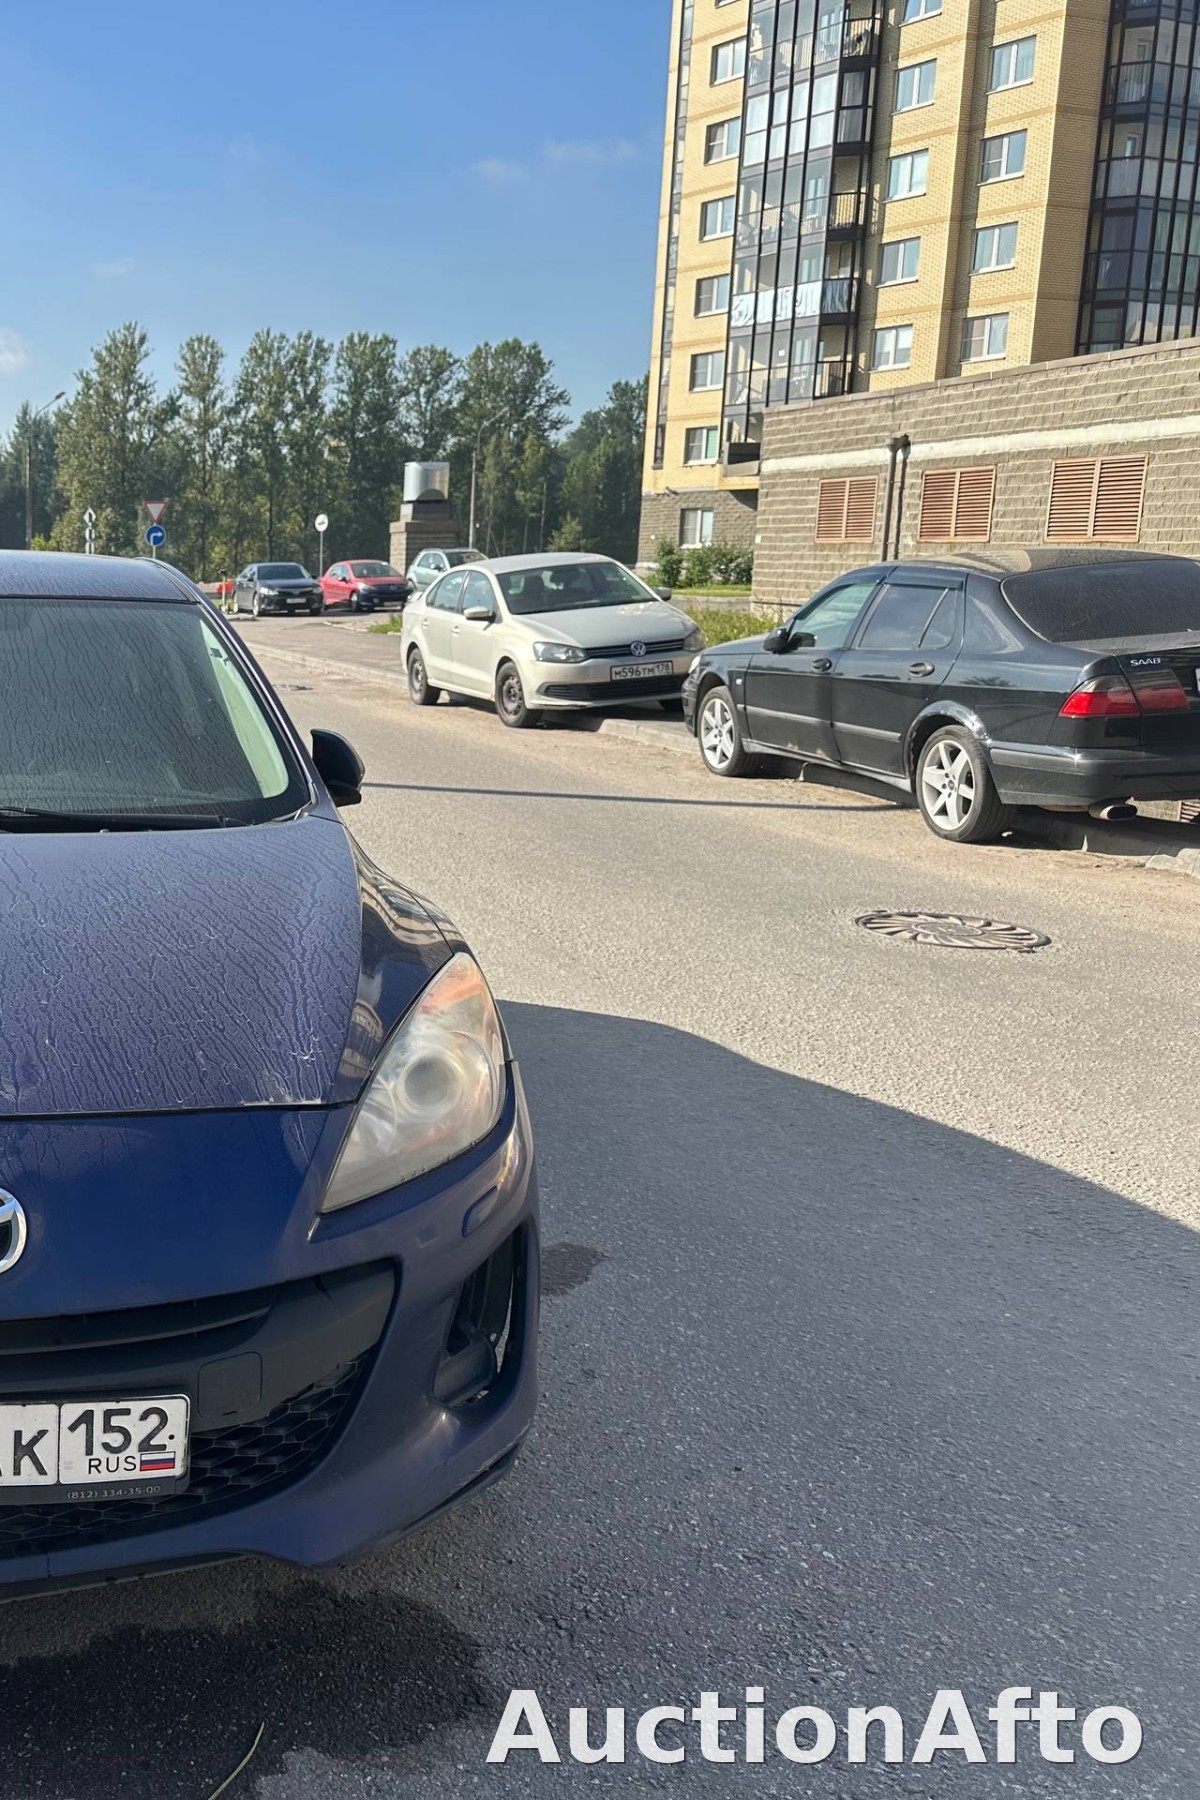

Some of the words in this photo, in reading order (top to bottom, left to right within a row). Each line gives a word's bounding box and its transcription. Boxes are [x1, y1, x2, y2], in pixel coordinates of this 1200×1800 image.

[1130, 657, 1161, 667] SAAB
[67, 1407, 169, 1456] 152
[88, 1455, 137, 1475] RUS
[67, 1490, 98, 1500] (812)
[101, 1485, 161, 1498] 334-35-00
